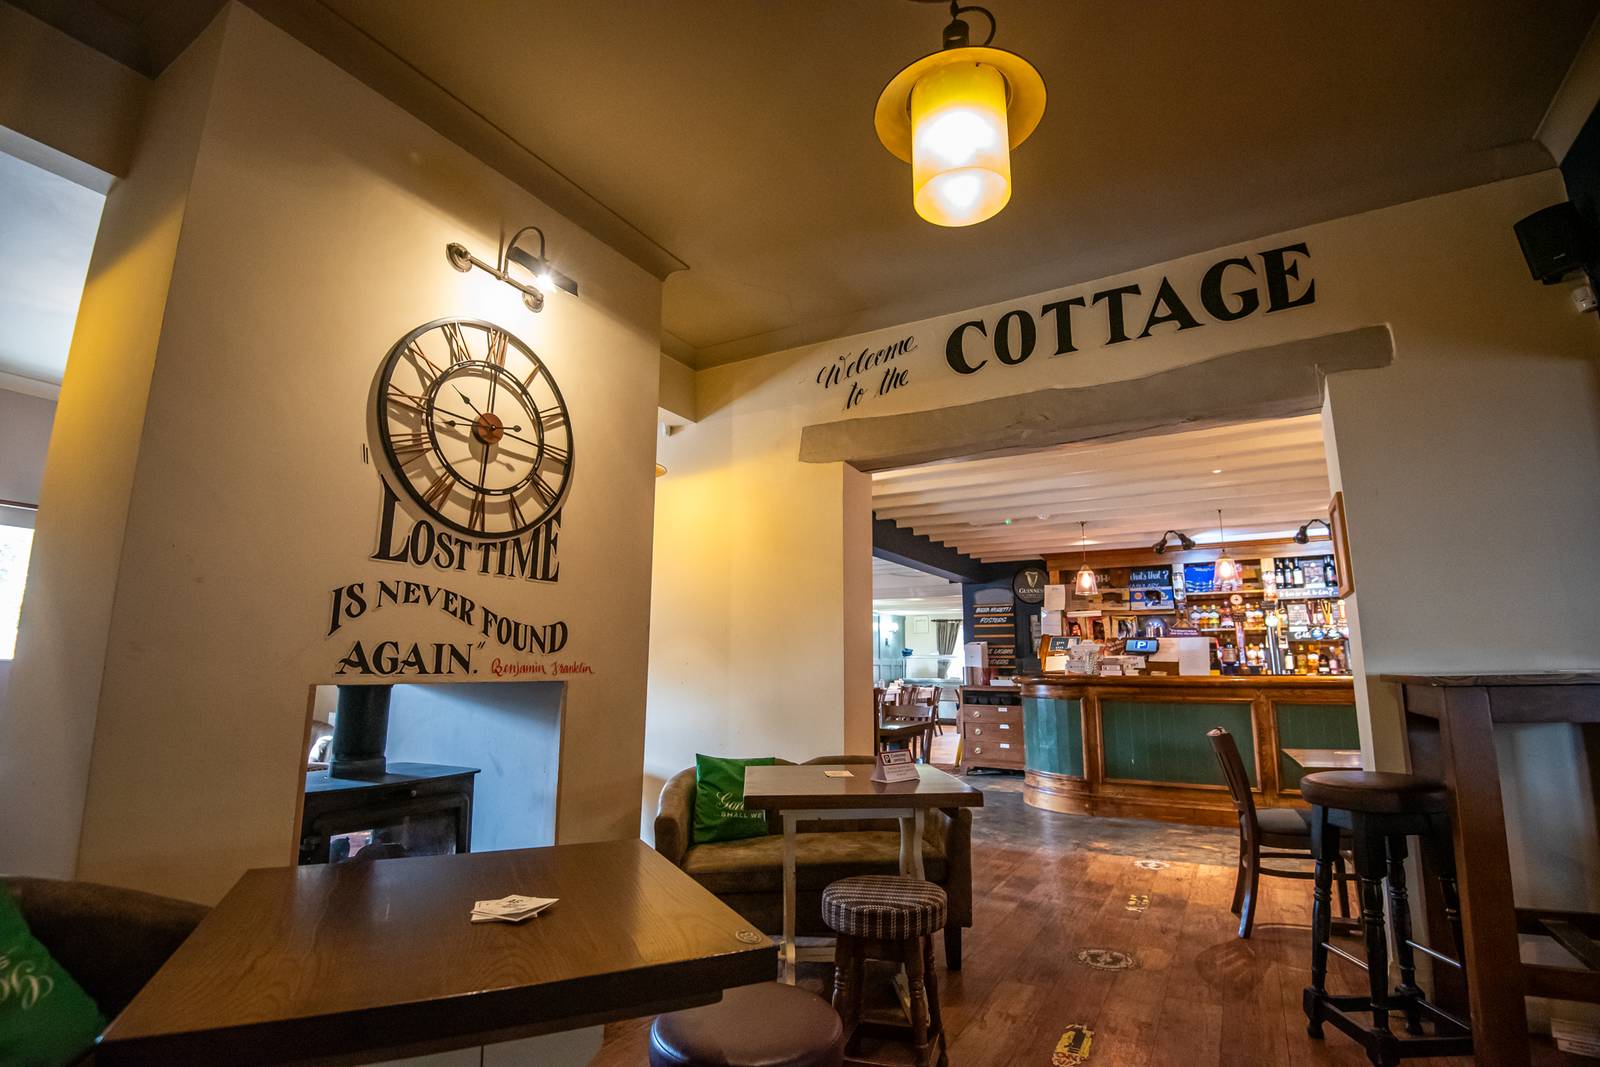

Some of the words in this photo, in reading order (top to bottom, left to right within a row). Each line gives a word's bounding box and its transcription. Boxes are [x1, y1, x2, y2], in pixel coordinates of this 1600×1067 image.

[945, 242, 1316, 375] COTTAGE
[816, 335, 918, 389] Welcome
[842, 382, 866, 411] to
[878, 367, 909, 396] the
[370, 474, 472, 570] LOST
[478, 506, 562, 582] TIME
[328, 582, 367, 636] IS
[376, 581, 476, 625] NEVER
[481, 606, 569, 655] FOUND
[491, 657, 546, 678] Benjamin
[551, 658, 594, 676] Franklin
